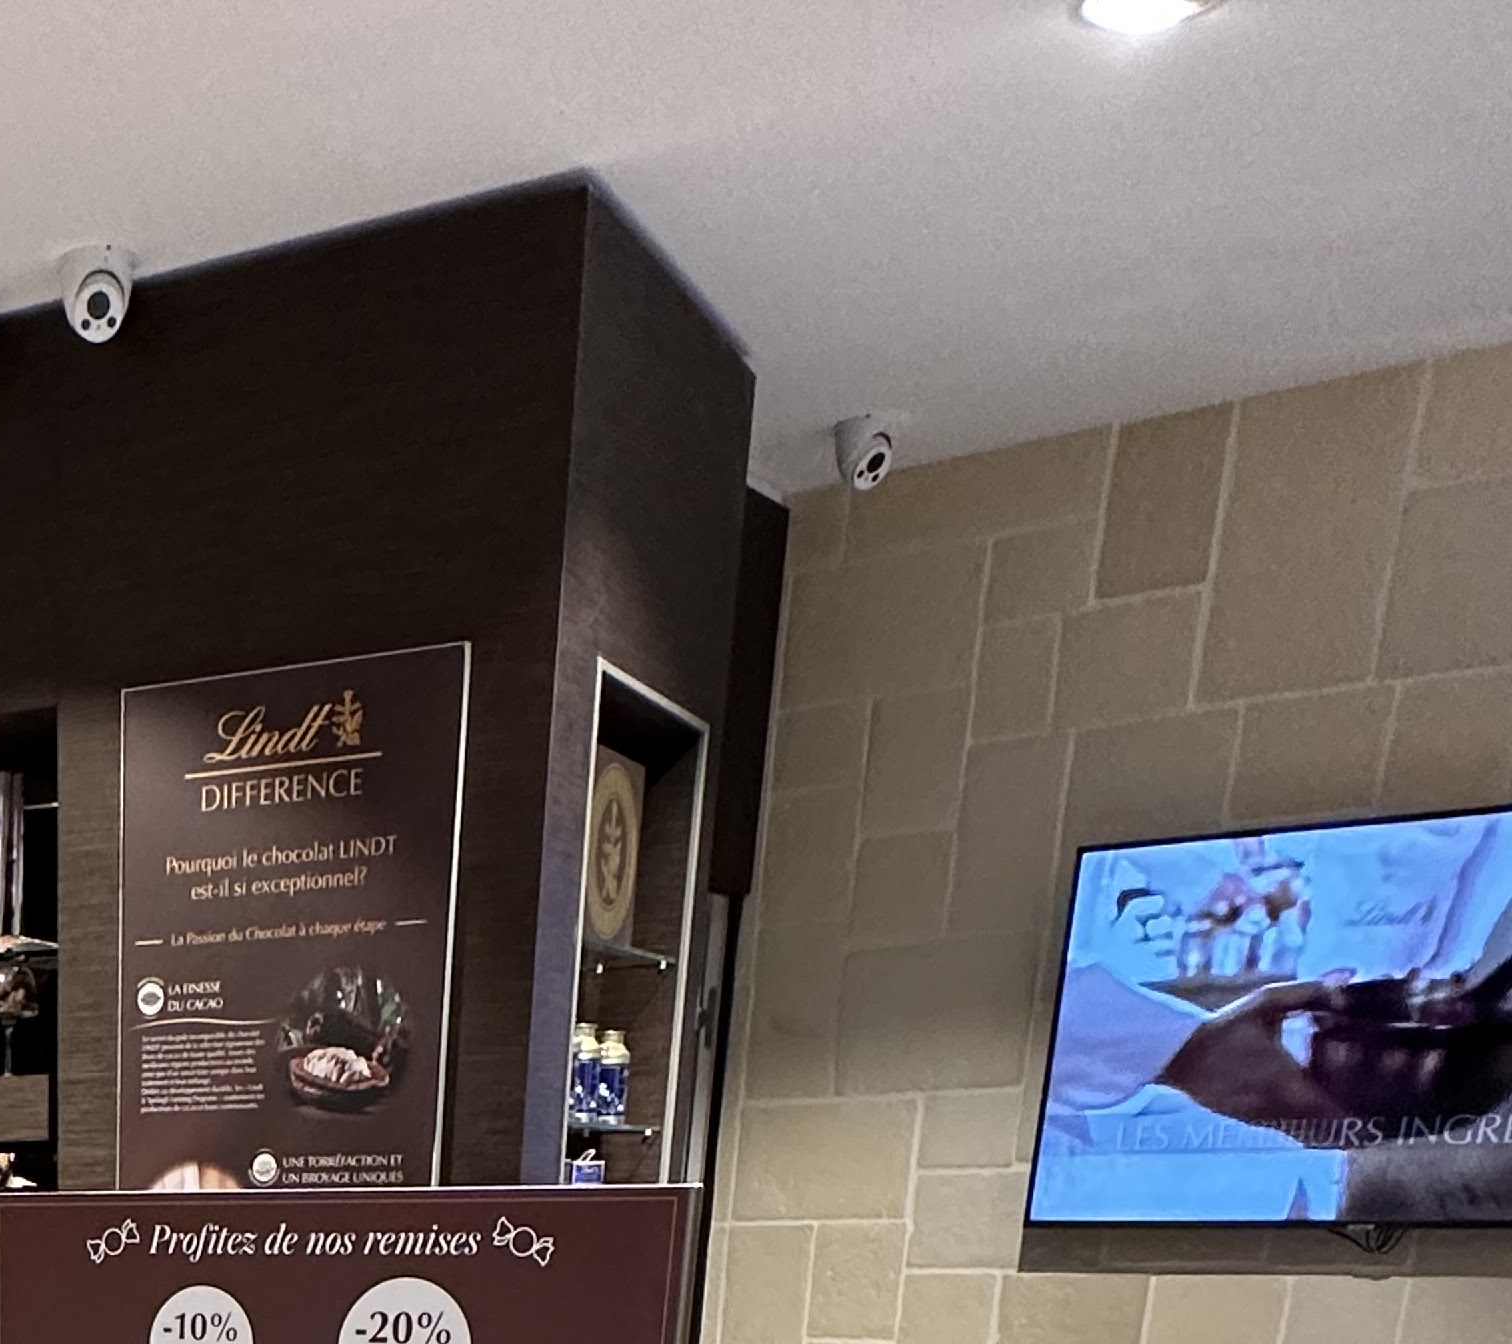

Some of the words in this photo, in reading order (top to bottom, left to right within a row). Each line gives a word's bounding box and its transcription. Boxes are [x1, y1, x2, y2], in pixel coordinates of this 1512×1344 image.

[203, 703, 332, 763] Lindt
[200, 768, 364, 812] DIFFERENCE
[166, 850, 238, 876] Pourquoi
[243, 848, 258, 868] le
[262, 842, 334, 865] chocolat
[340, 835, 397, 859] LINDT
[190, 878, 230, 900] est-il
[234, 880, 246, 897] si
[252, 866, 368, 897] exceptionnel?
[171, 934, 184, 946] La
[186, 929, 226, 945] Passion
[228, 927, 243, 942] du
[245, 923, 296, 940] Chocolat
[309, 920, 351, 939] chaque
[186, 998, 224, 1011] CACAO
[1116, 1119, 1170, 1150] LES
[281, 1171, 299, 1184] UN
[301, 1170, 351, 1184] BROYAGE
[353, 1170, 404, 1184] UNIQUES
[149, 1223, 258, 1264] Profitez
[265, 1226, 298, 1255] de
[306, 1229, 356, 1255] nos
[363, 1224, 481, 1256] remises
[162, 1312, 238, 1342] -10%
